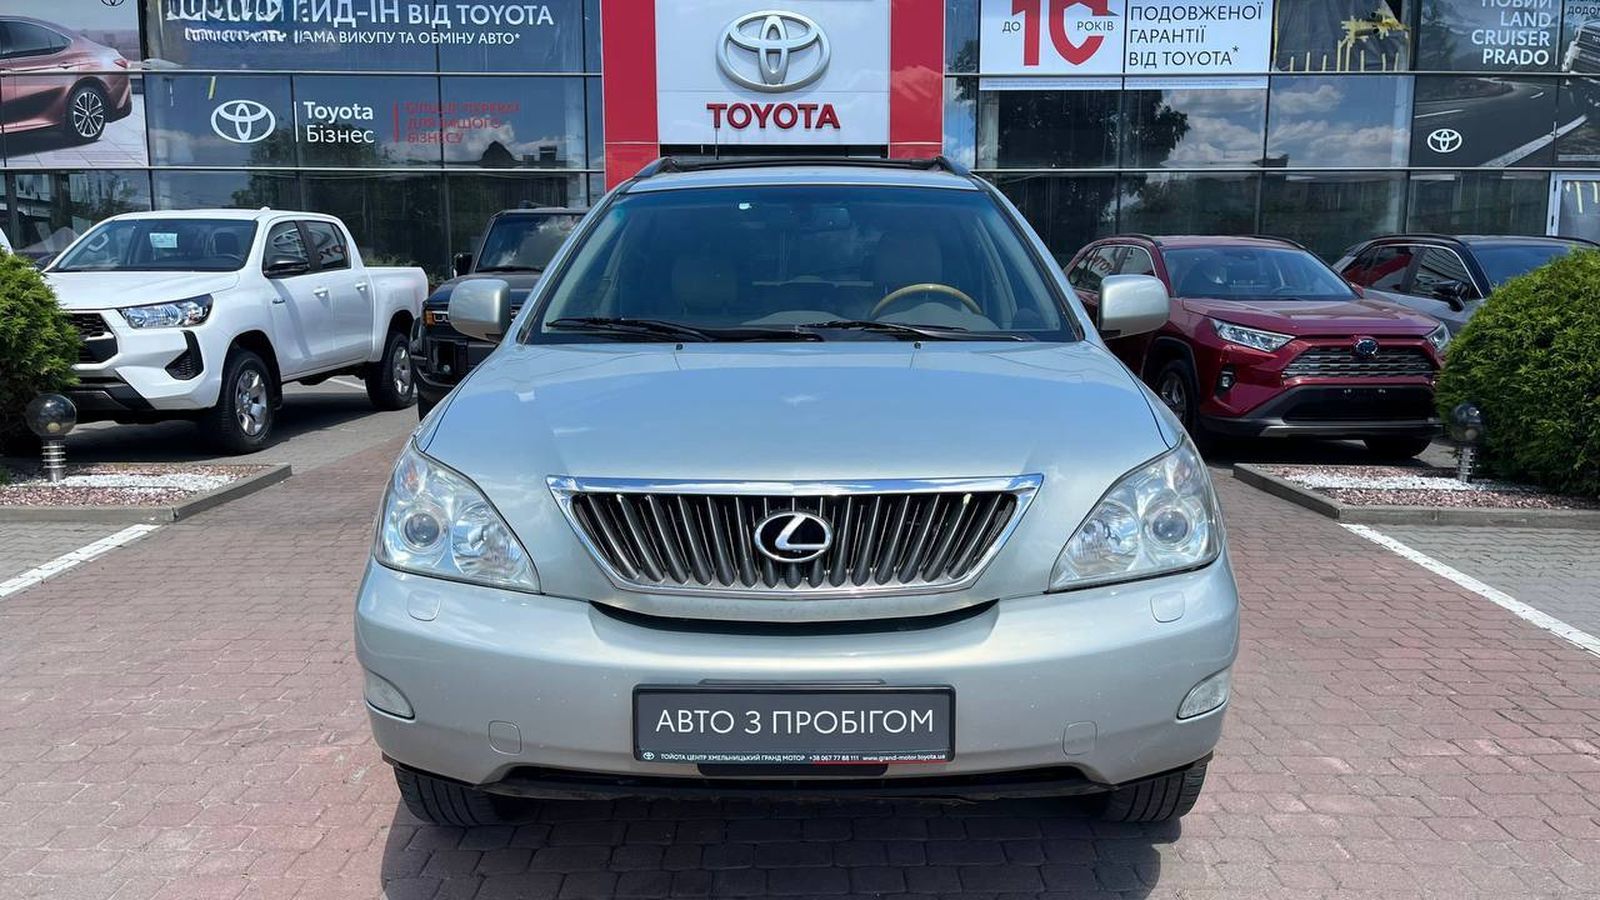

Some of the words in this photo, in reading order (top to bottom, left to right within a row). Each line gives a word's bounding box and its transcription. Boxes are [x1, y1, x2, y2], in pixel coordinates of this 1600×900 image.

[408, 4, 451, 29] ВІД
[456, 4, 554, 25] TOYOTA
[1130, 2, 1264, 23] ПОДОВЖЕНОЇ
[1500, 11, 1551, 27] LAND
[1002, 21, 1021, 33] ДО
[1076, 20, 1115, 31] РОКІВ
[1129, 25, 1207, 43] ГАРАНТІЇ
[339, 30, 396, 44] ВИКУПУ
[398, 32, 416, 44] ТА
[418, 32, 475, 44] ОБМІНУ
[1471, 29, 1551, 46] CRUISER
[1129, 51, 1157, 69] ВІД
[1482, 48, 1549, 65] PRADO
[303, 101, 373, 124] Toyota
[706, 102, 841, 130] TOYOTA
[306, 124, 375, 144] Бізнес
[655, 709, 735, 734] АВТО
[744, 710, 762, 734] З
[772, 709, 934, 734] ПРОБІГОМ
[660, 753, 686, 761] ТОЙОТА
[761, 754, 781, 762] ГРАНД
